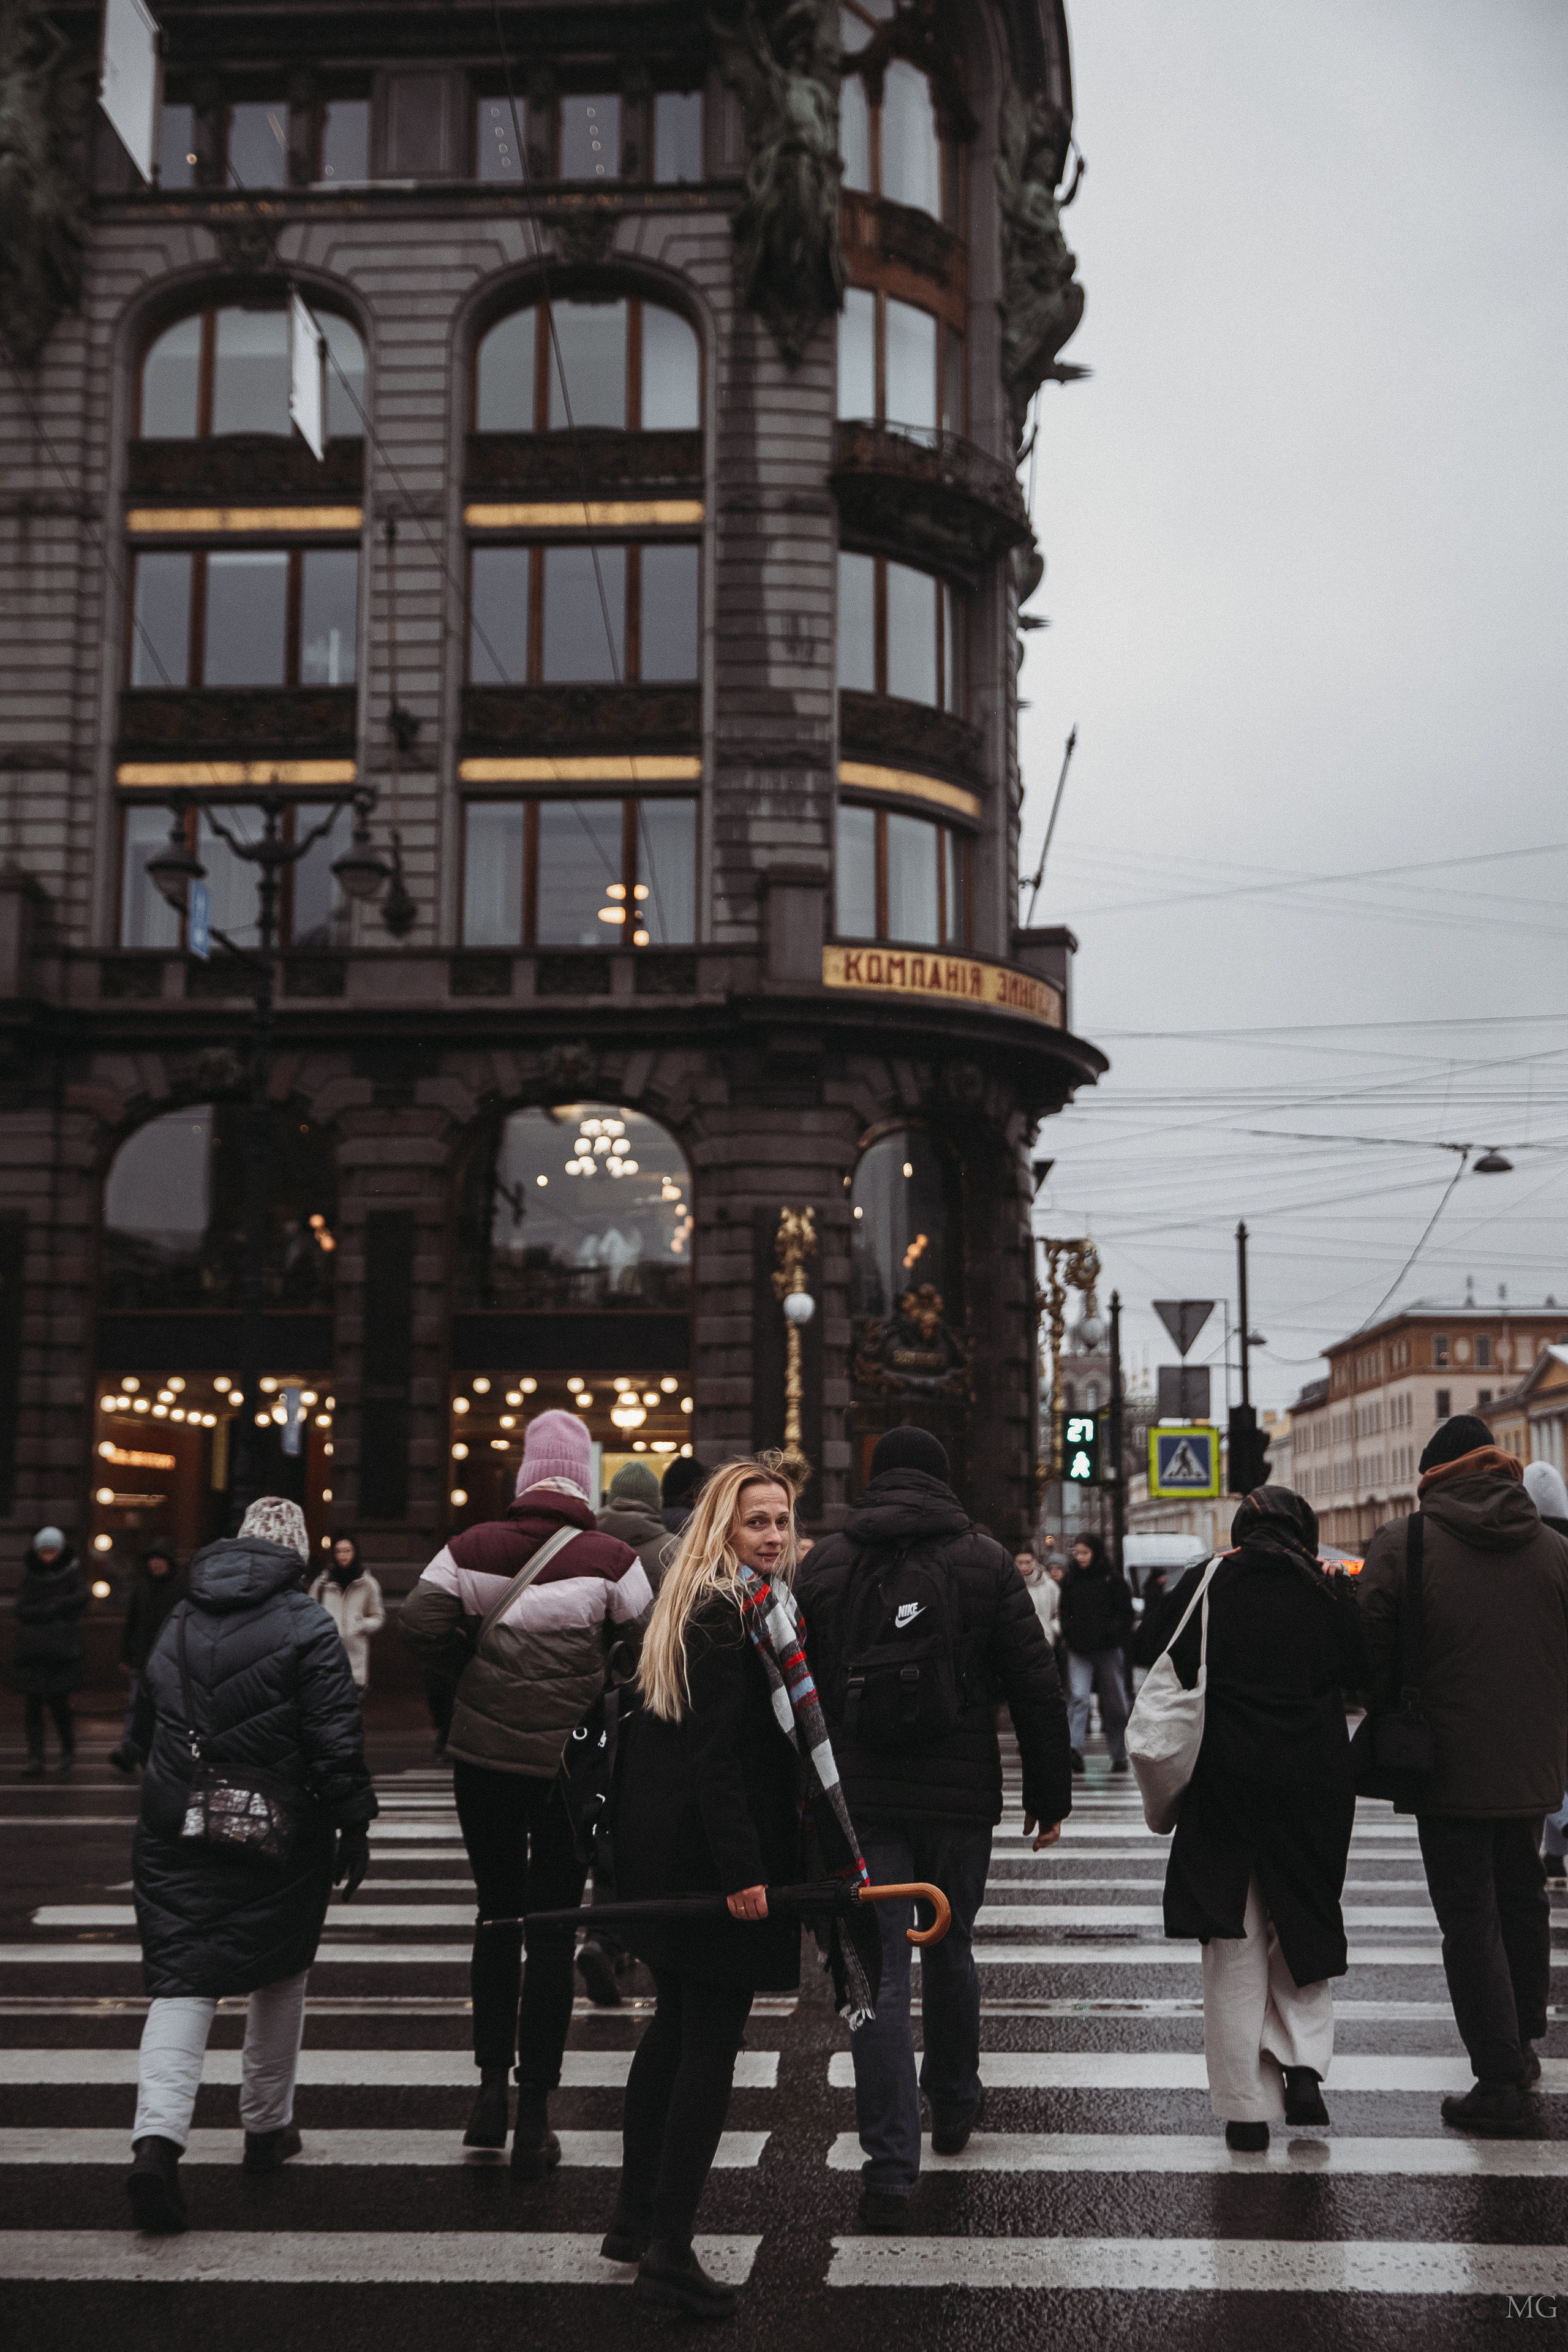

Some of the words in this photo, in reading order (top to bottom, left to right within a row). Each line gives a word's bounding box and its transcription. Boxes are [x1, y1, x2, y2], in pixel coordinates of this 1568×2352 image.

[844, 952, 983, 997] КОМПАНІЯ
[1067, 1418, 1093, 1442] 27
[898, 1602, 918, 1618] NIKE
